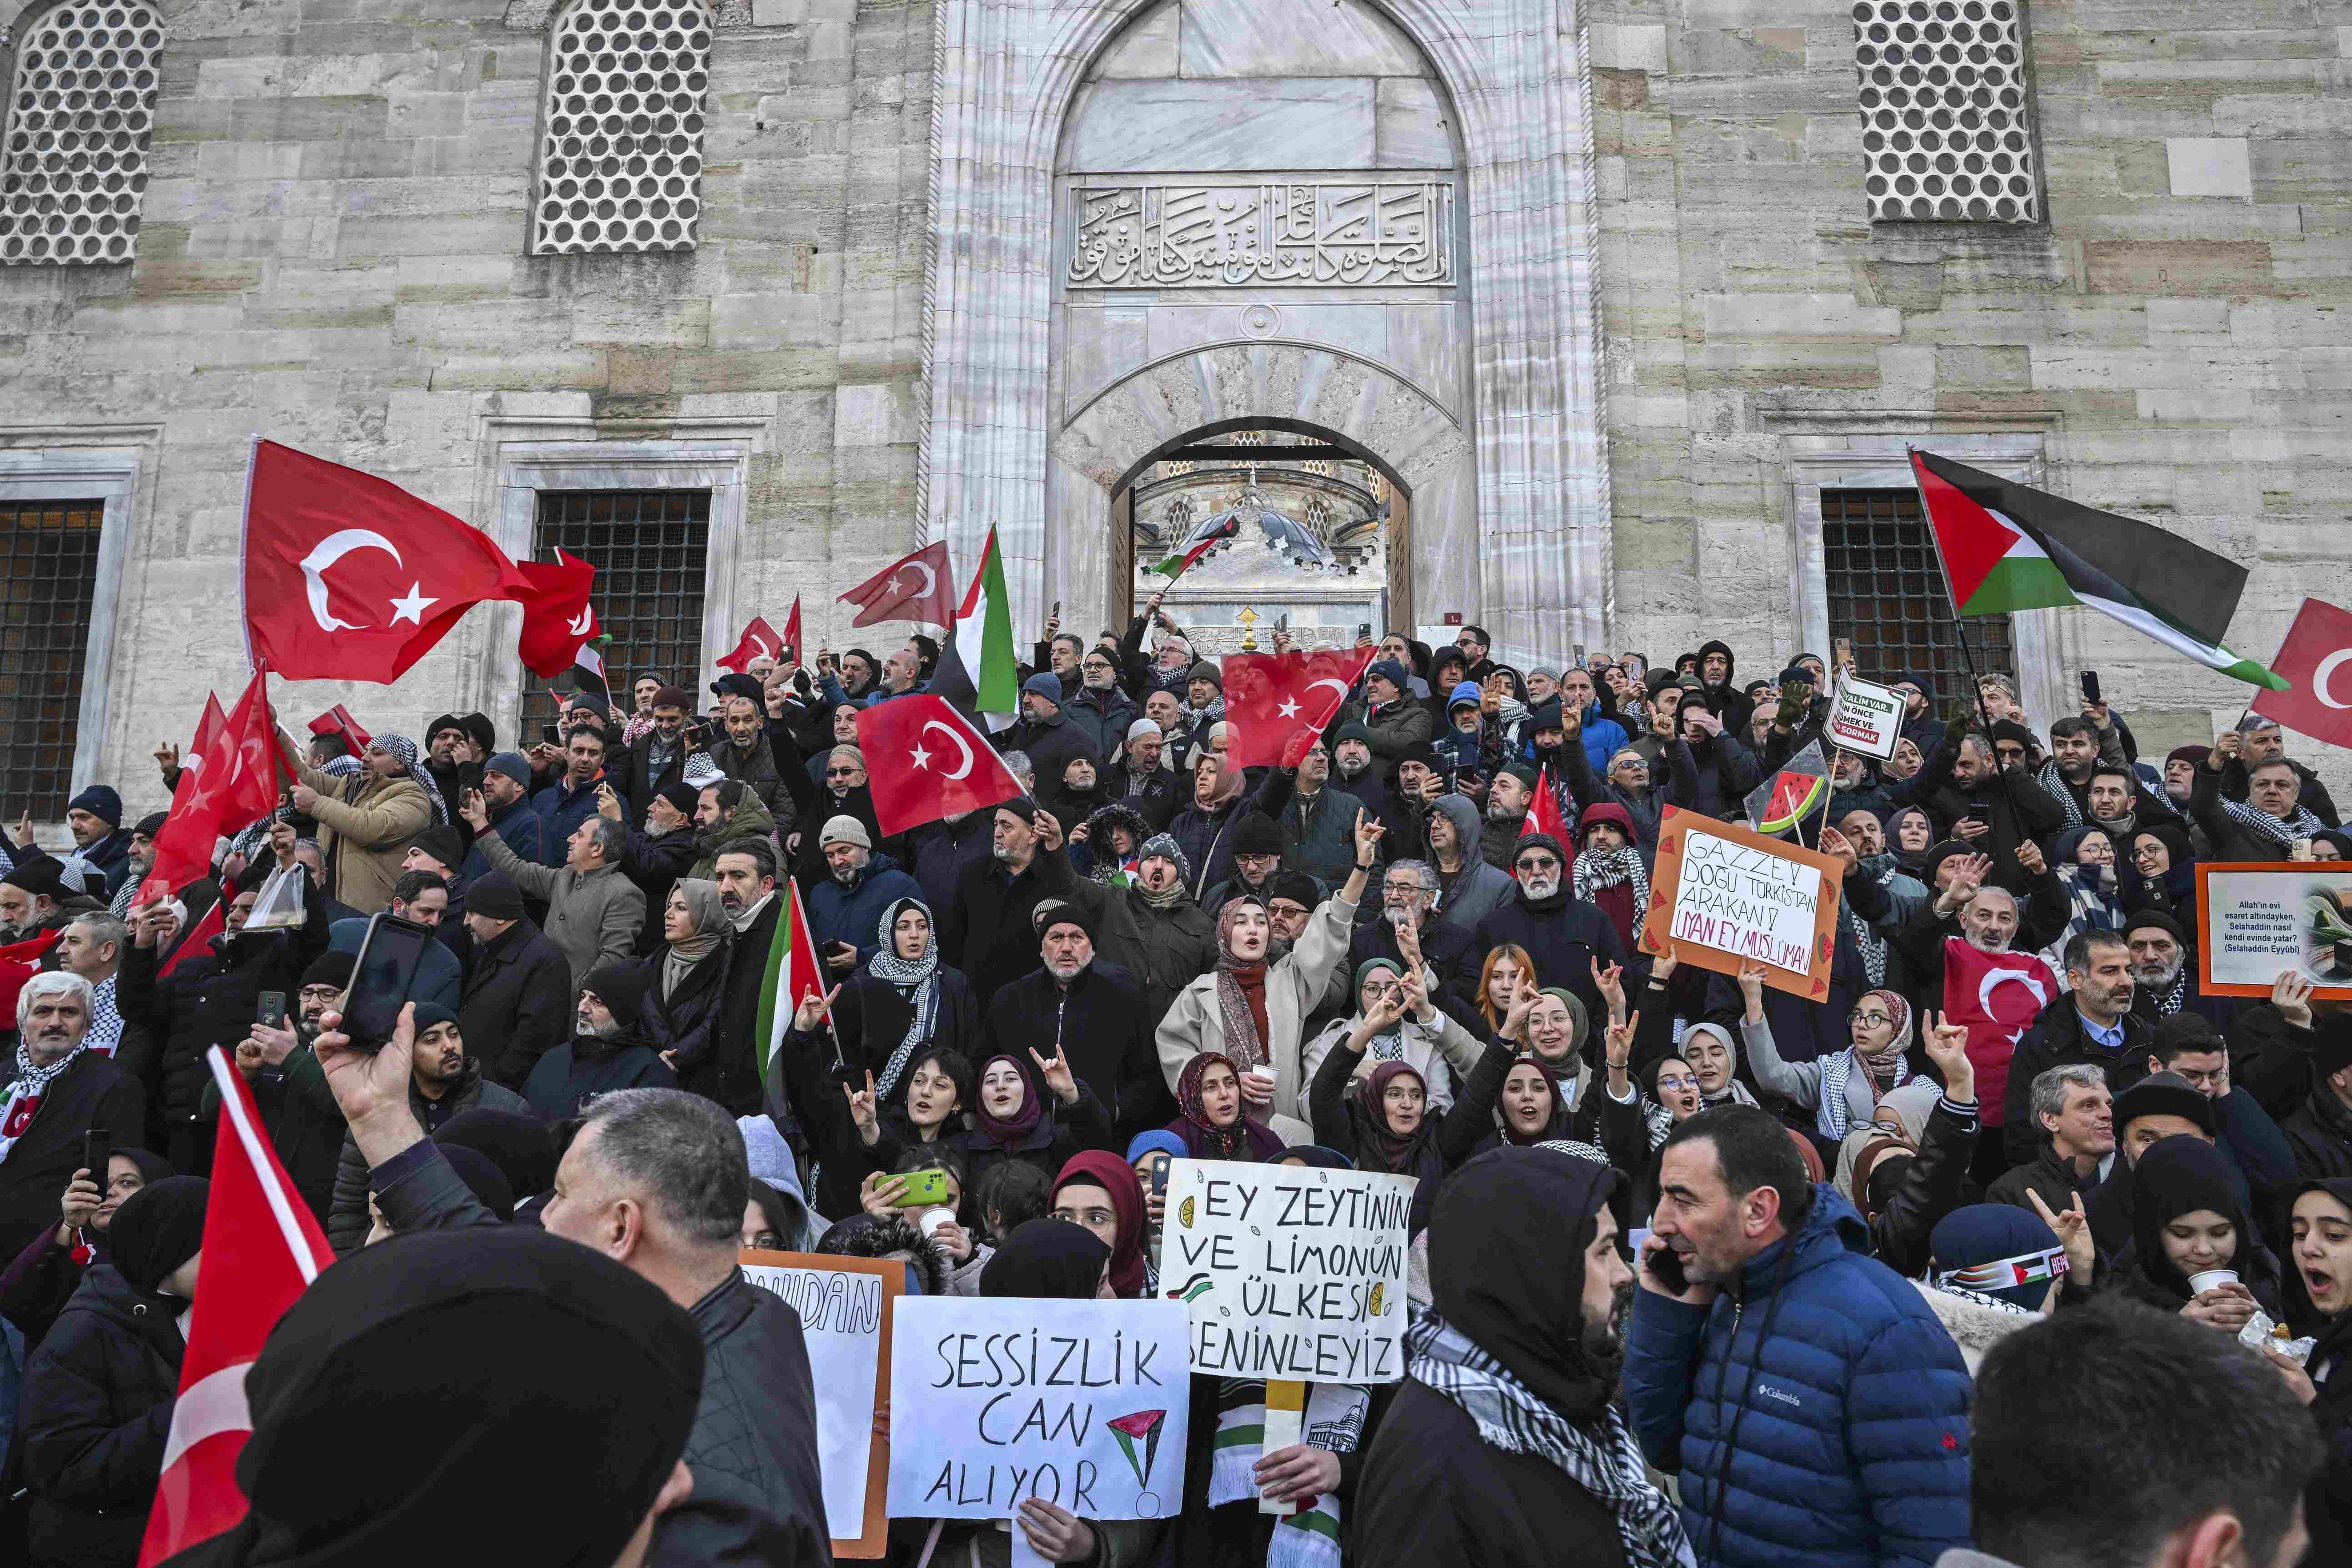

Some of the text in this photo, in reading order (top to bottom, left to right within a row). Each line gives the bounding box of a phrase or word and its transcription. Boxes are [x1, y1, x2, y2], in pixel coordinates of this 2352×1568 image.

[1851, 704, 1874, 719] ÖNCE
[1869, 700, 1888, 711] VAR.
[1841, 726, 1877, 742] SORMAK
[1683, 858, 1738, 892] DOĞU
[1676, 909, 1716, 943] UYAN
[1718, 921, 1740, 949] EY
[2230, 923, 2271, 931] Selahaddin
[2250, 913, 2296, 922] altındayken,
[2225, 933, 2244, 941] kendi
[2273, 935, 2297, 943] yatar?
[2225, 944, 2300, 955] (Selahaddin Eyyûbî)
[1206, 1181, 1412, 1231] EY ZEYTİNİN
[1179, 1235, 1239, 1270] VE
[1243, 1274, 1370, 1323] ÜLKESİ
[931, 1327, 1163, 1388] SESSİZLİK
[1768, 1387, 1800, 1407] Columbia
[978, 1392, 1093, 1447] CAN
[923, 1460, 1098, 1512] ALIYOR
